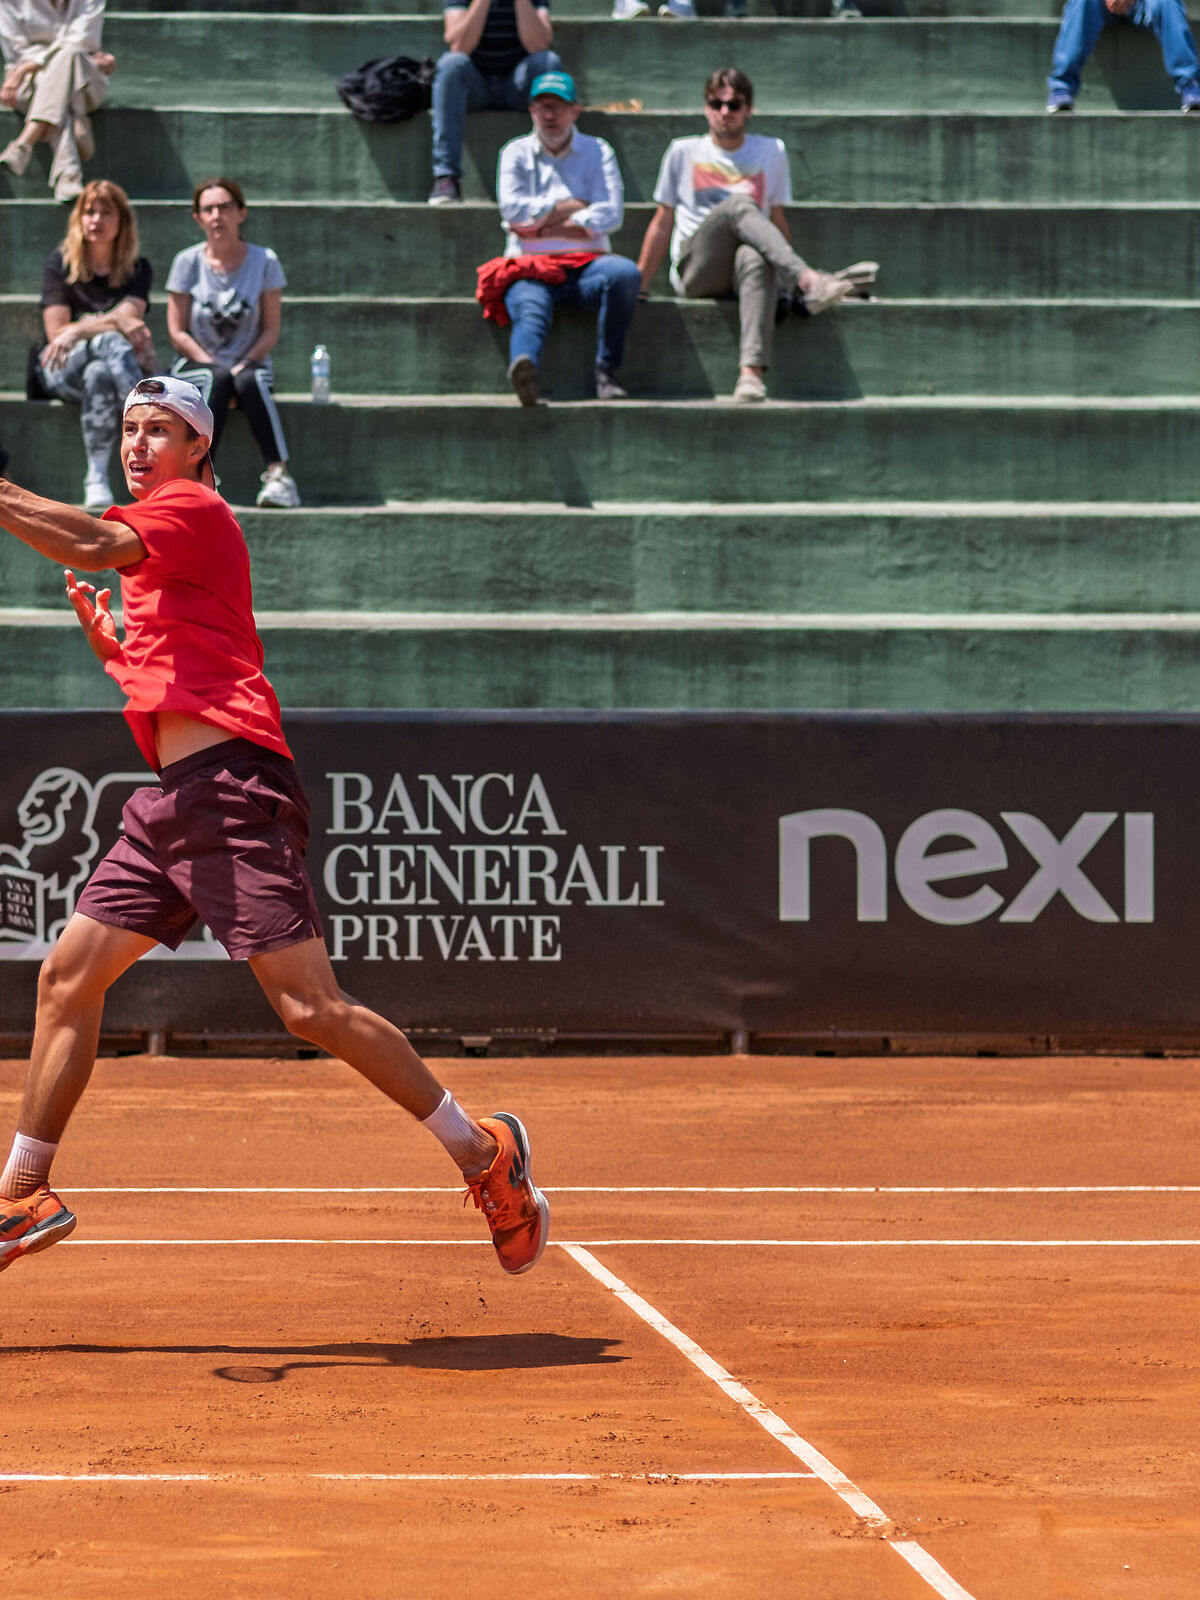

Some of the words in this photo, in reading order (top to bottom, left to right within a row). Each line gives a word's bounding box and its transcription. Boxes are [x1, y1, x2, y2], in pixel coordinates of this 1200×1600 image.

[326, 773, 566, 836] BANCA
[323, 845, 665, 906] GENERALI
[329, 915, 562, 962] PRIVATE
